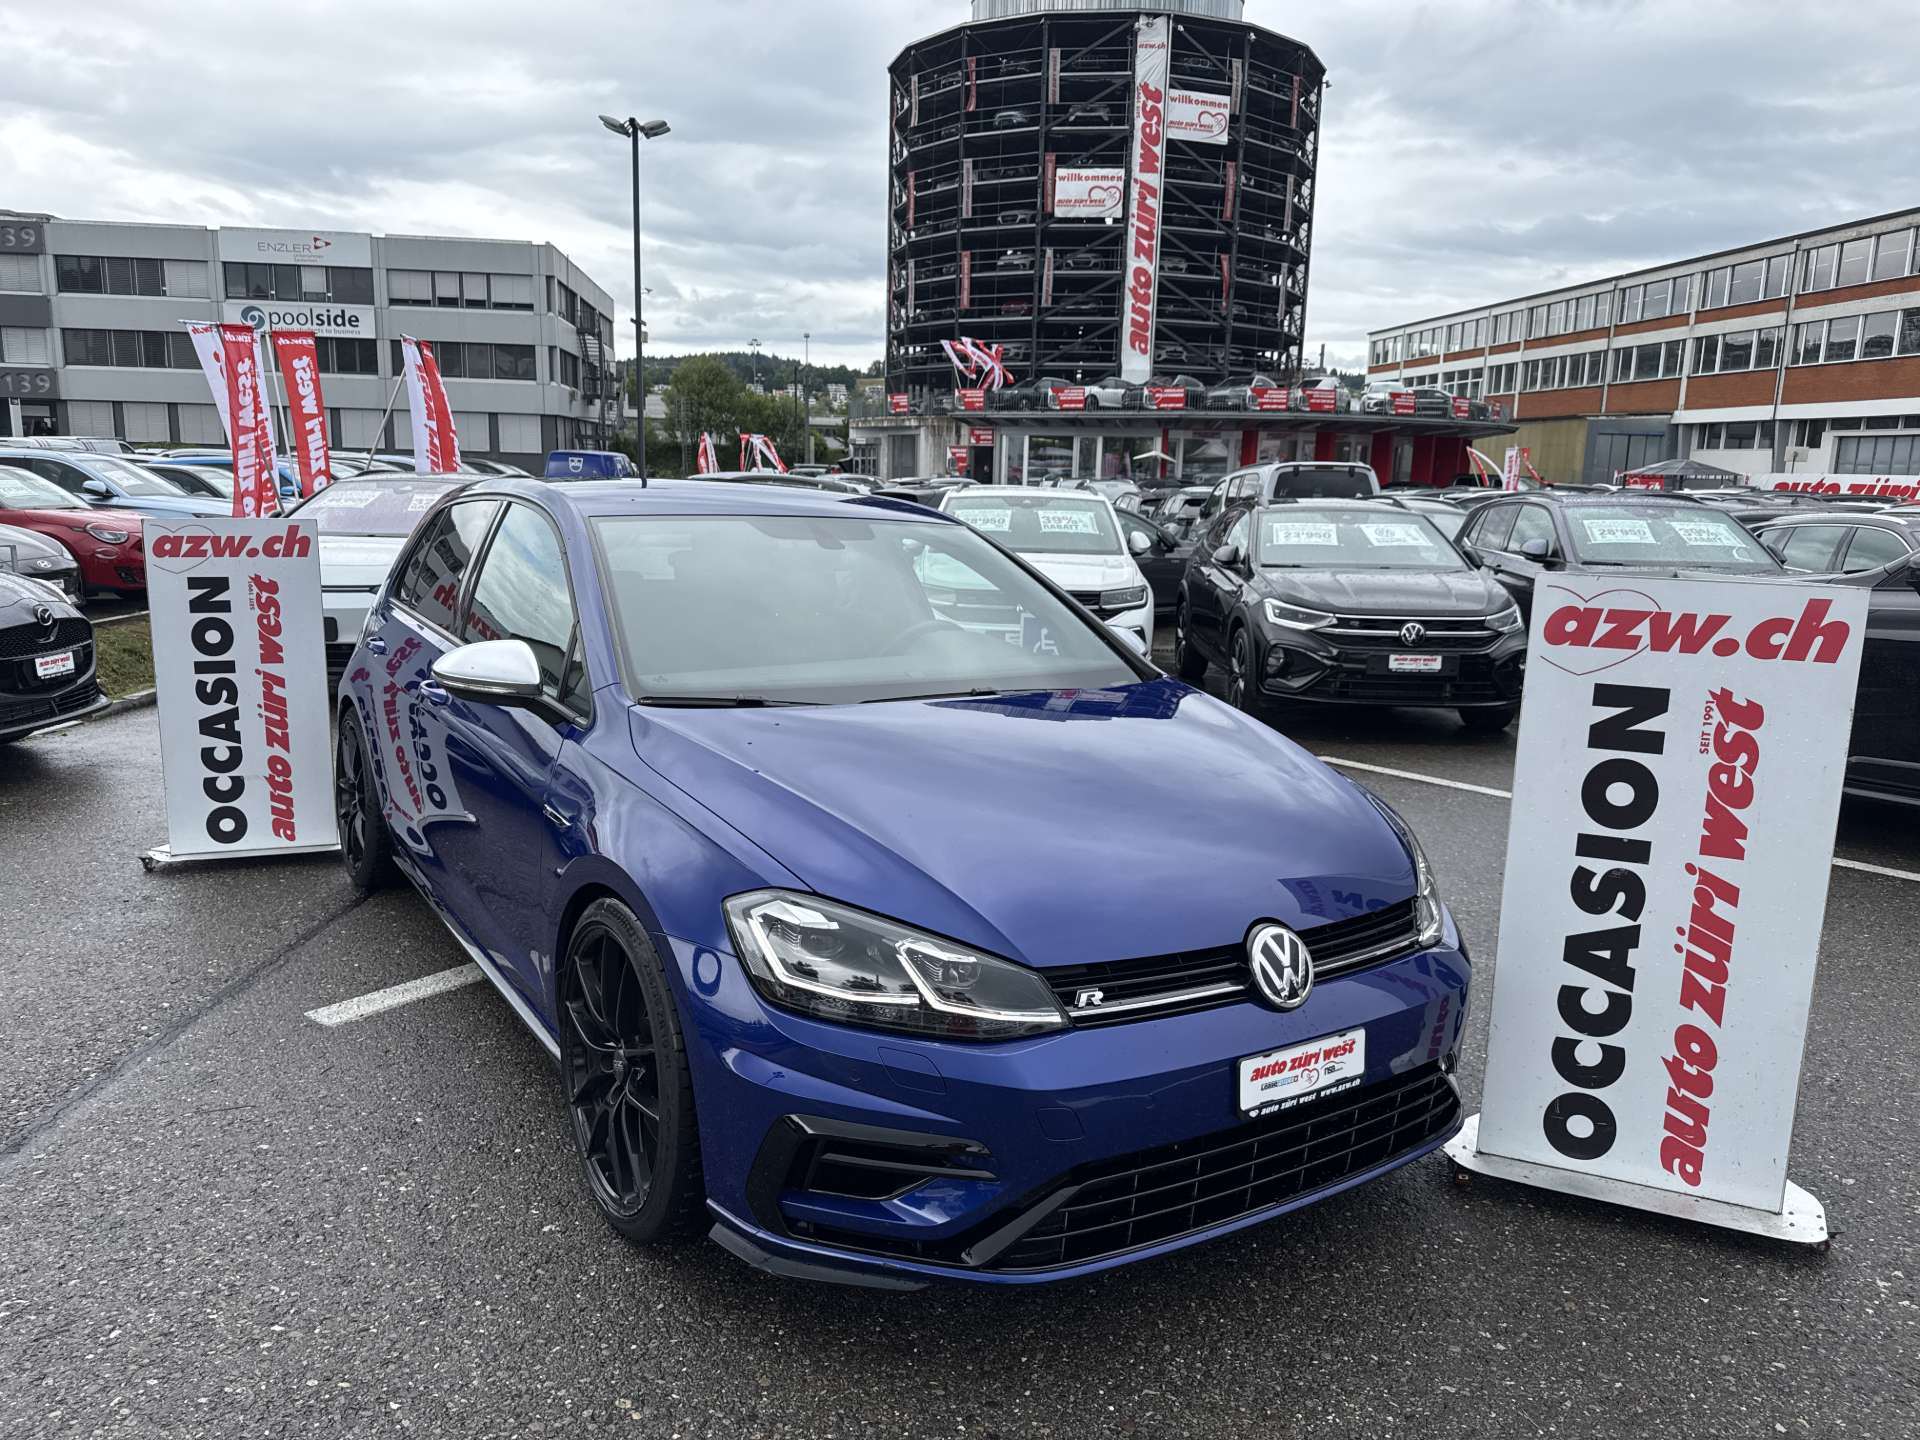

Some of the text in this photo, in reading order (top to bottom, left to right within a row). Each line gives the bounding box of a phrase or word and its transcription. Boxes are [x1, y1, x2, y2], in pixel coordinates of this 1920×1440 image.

[1138, 41, 1167, 50] azw.ch
[1168, 94, 1229, 109] willkommen
[1058, 172, 1123, 182] willkommen
[1129, 80, 1164, 356] auto züri west
[257, 241, 312, 254] ENZLER
[268, 306, 360, 331] poolside
[5, 374, 50, 393] 139
[153, 525, 310, 557] azw.ch
[1544, 598, 1850, 664] azw.ch
[187, 576, 248, 845] OCCASION
[248, 573, 296, 841] auto züri west
[1699, 700, 1716, 755] SEIT 1991
[1543, 682, 1671, 1161] OCCASION
[1660, 686, 1765, 1187] auto züri west
[1250, 1059, 1288, 1082] auto
[1289, 1048, 1322, 1072] züri
[1323, 1038, 1356, 1062] west
[1261, 1078, 1361, 1115] auto züri west www.azw.ch
